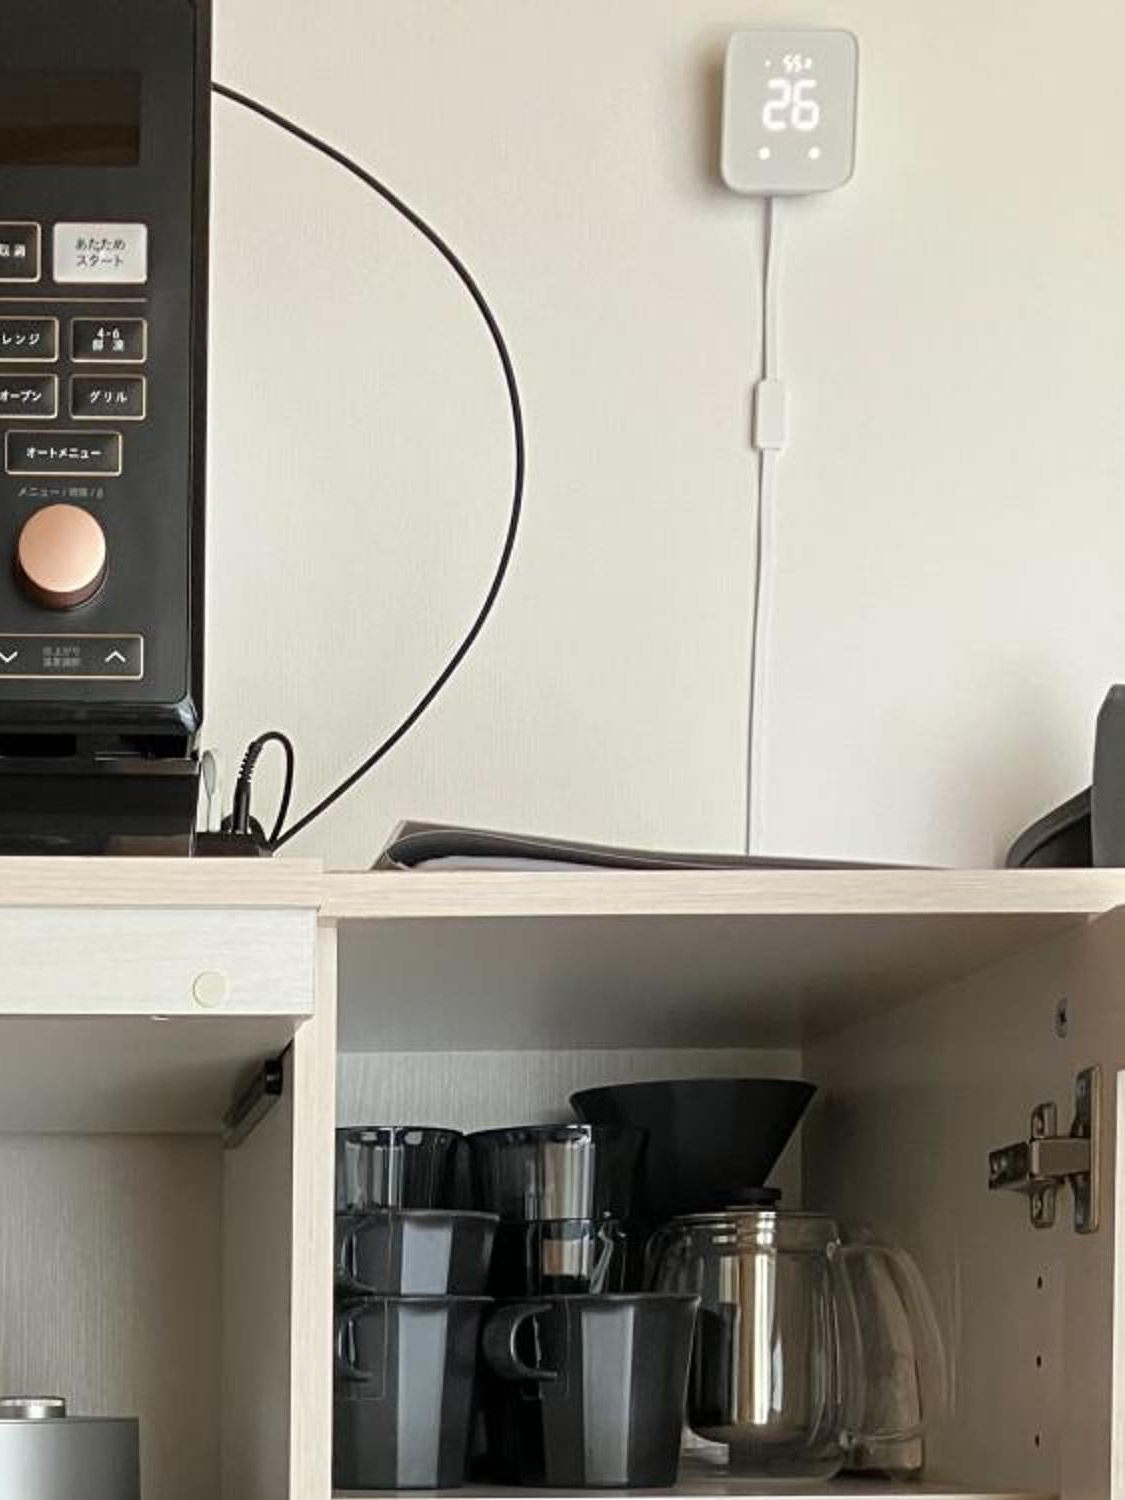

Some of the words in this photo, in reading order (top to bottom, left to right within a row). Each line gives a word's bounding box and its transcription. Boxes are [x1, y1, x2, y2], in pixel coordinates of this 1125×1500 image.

[762, 78, 820, 131] 26
[75, 238, 127, 251] あたため
[76, 255, 124, 267] スタート
[2, 332, 41, 346] レンジ
[90, 389, 128, 404] グリル
[26, 447, 103, 459] オートメニュー
